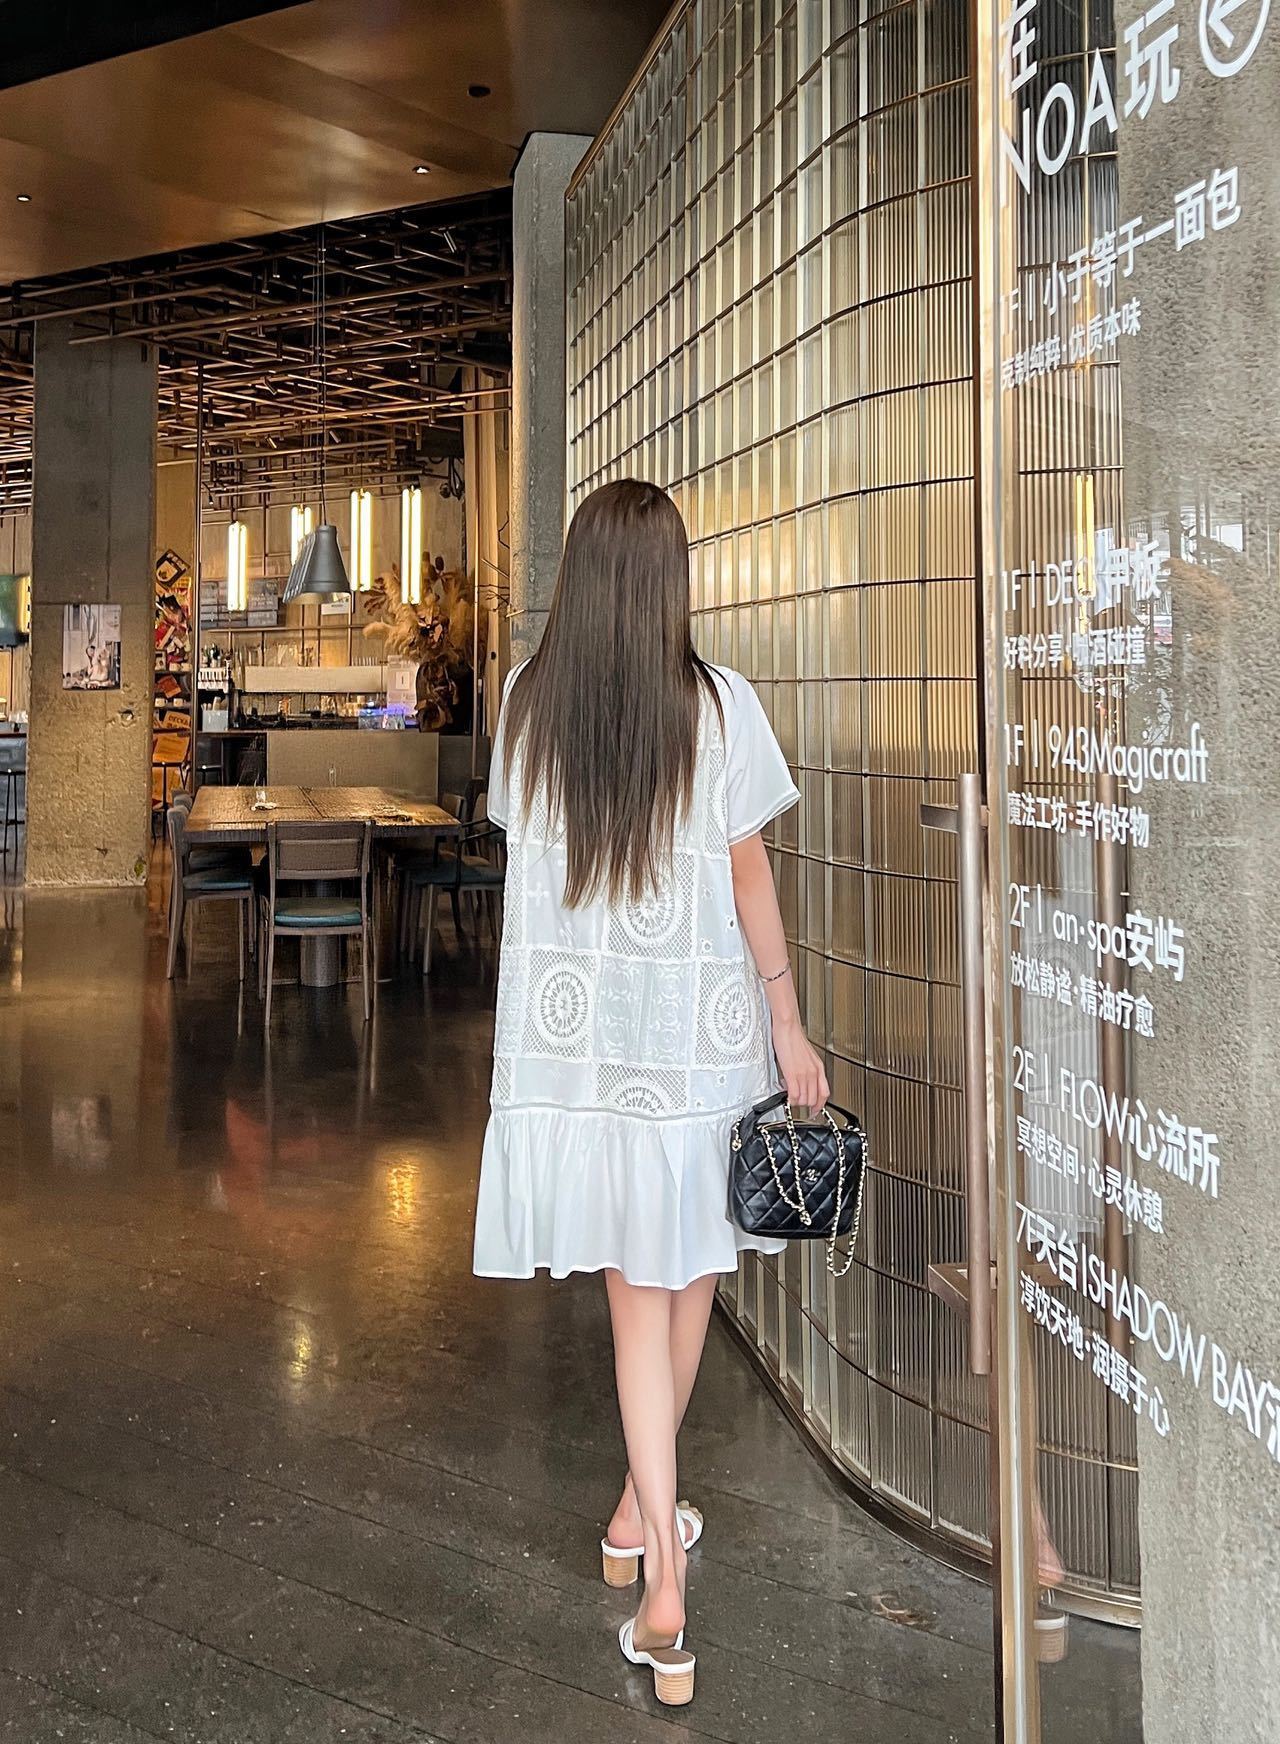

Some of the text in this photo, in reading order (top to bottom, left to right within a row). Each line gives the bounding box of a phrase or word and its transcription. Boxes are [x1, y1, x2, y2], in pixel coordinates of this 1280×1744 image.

[1043, 166, 1242, 316] 小于等于一面包
[1001, 569, 1022, 611] 1F
[1003, 723, 1023, 767] 1F
[1048, 721, 1209, 794] 943Magicraft
[1007, 790, 1149, 848] 魔法工坊·手作好物
[1008, 882, 1030, 929] 2F
[1010, 950, 1155, 1039] 放松静谧·精油疗愈
[1012, 1045, 1034, 1096] 2F
[1060, 1066, 1220, 1200] FLOW心流所
[1016, 1114, 1165, 1235] 冥想空间·心灵休憩
[1088, 1253, 1206, 1389] SHADOW
